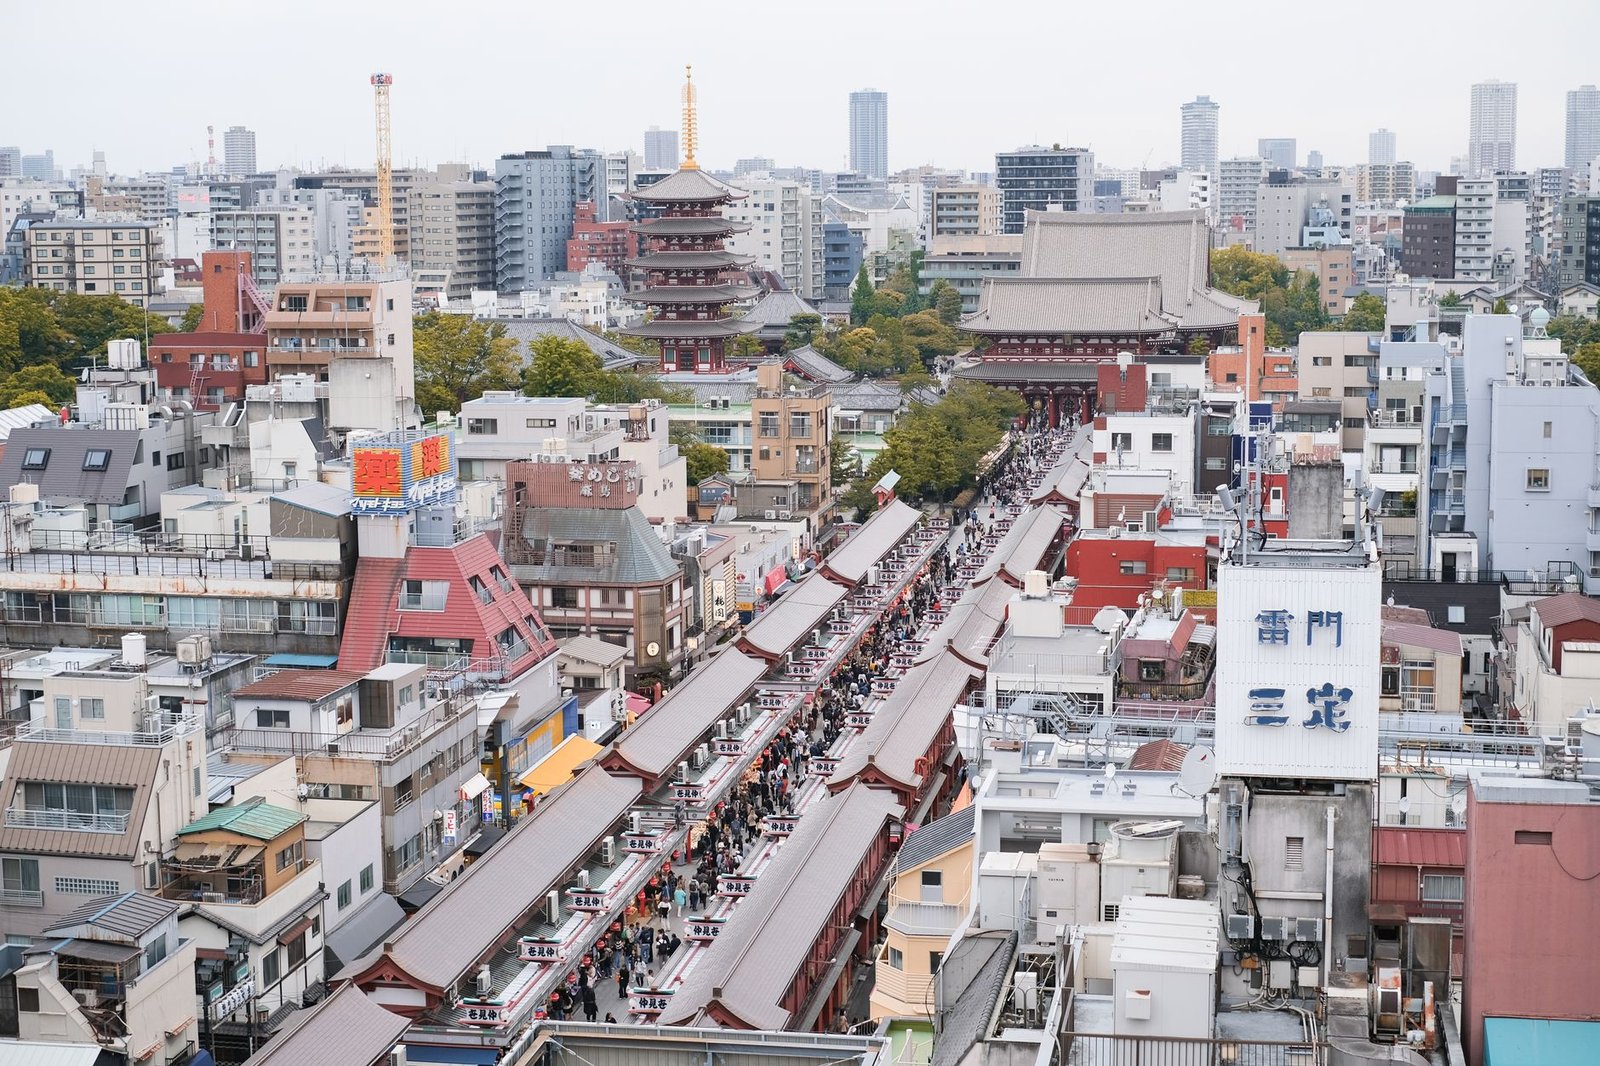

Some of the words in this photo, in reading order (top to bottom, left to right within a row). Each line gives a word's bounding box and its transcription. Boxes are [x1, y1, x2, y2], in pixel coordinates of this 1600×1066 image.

[353, 450, 400, 494] 薬
[421, 436, 441, 477] 薬
[1255, 609, 1343, 648] 雷門
